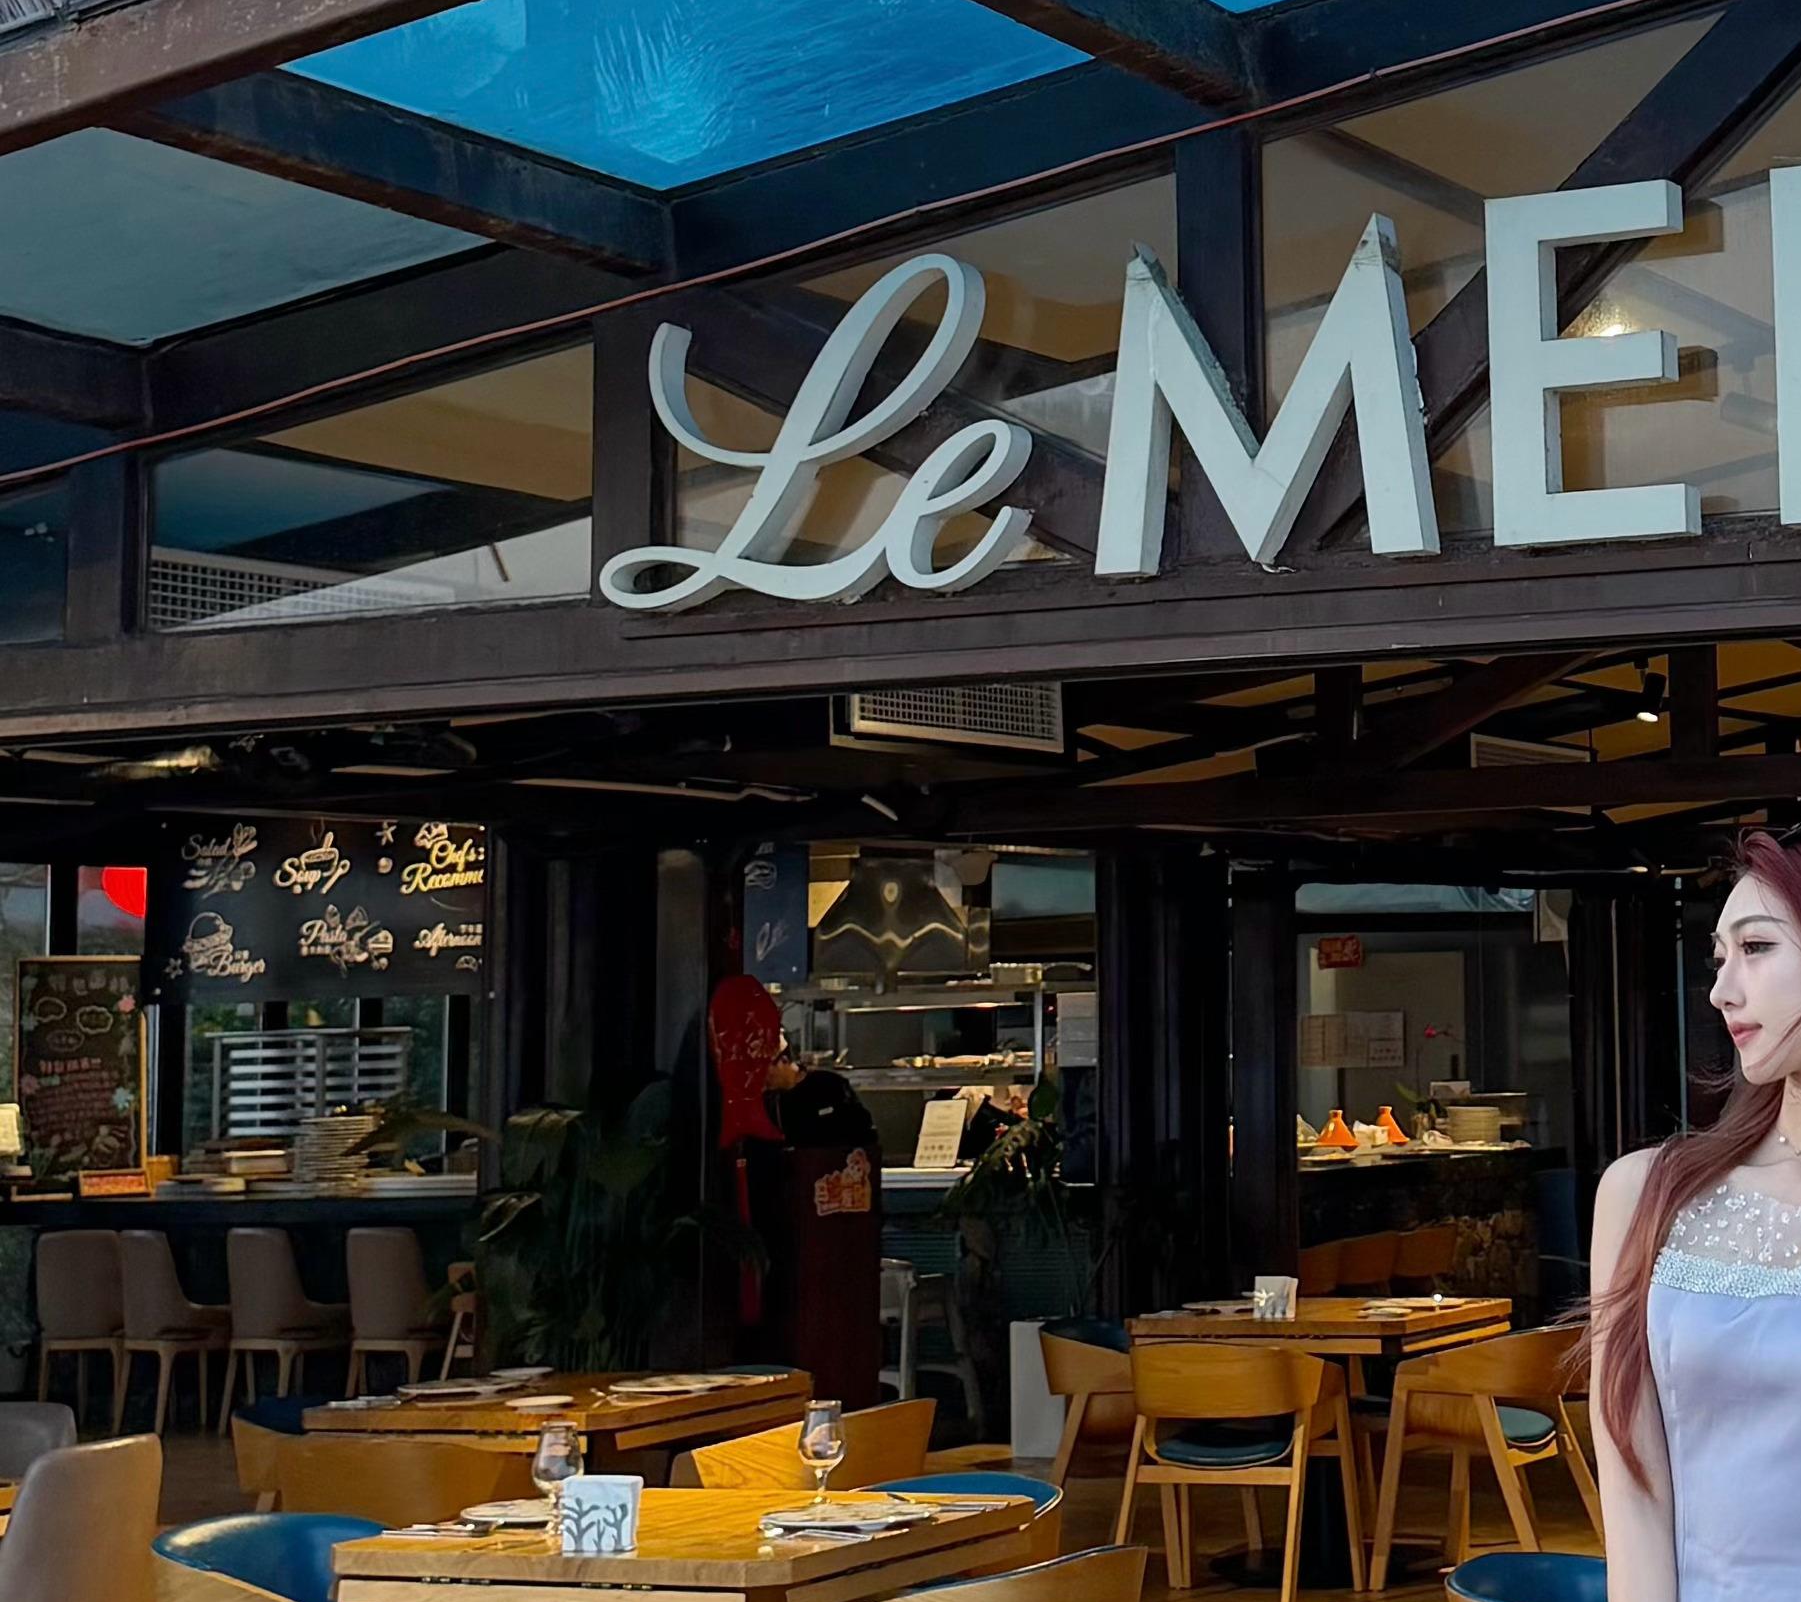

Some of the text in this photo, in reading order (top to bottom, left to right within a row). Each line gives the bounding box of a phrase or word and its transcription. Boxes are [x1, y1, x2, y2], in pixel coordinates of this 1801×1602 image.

[600, 253, 1034, 610] Le
[272, 857, 322, 891] Soup
[207, 951, 266, 984] Burger
